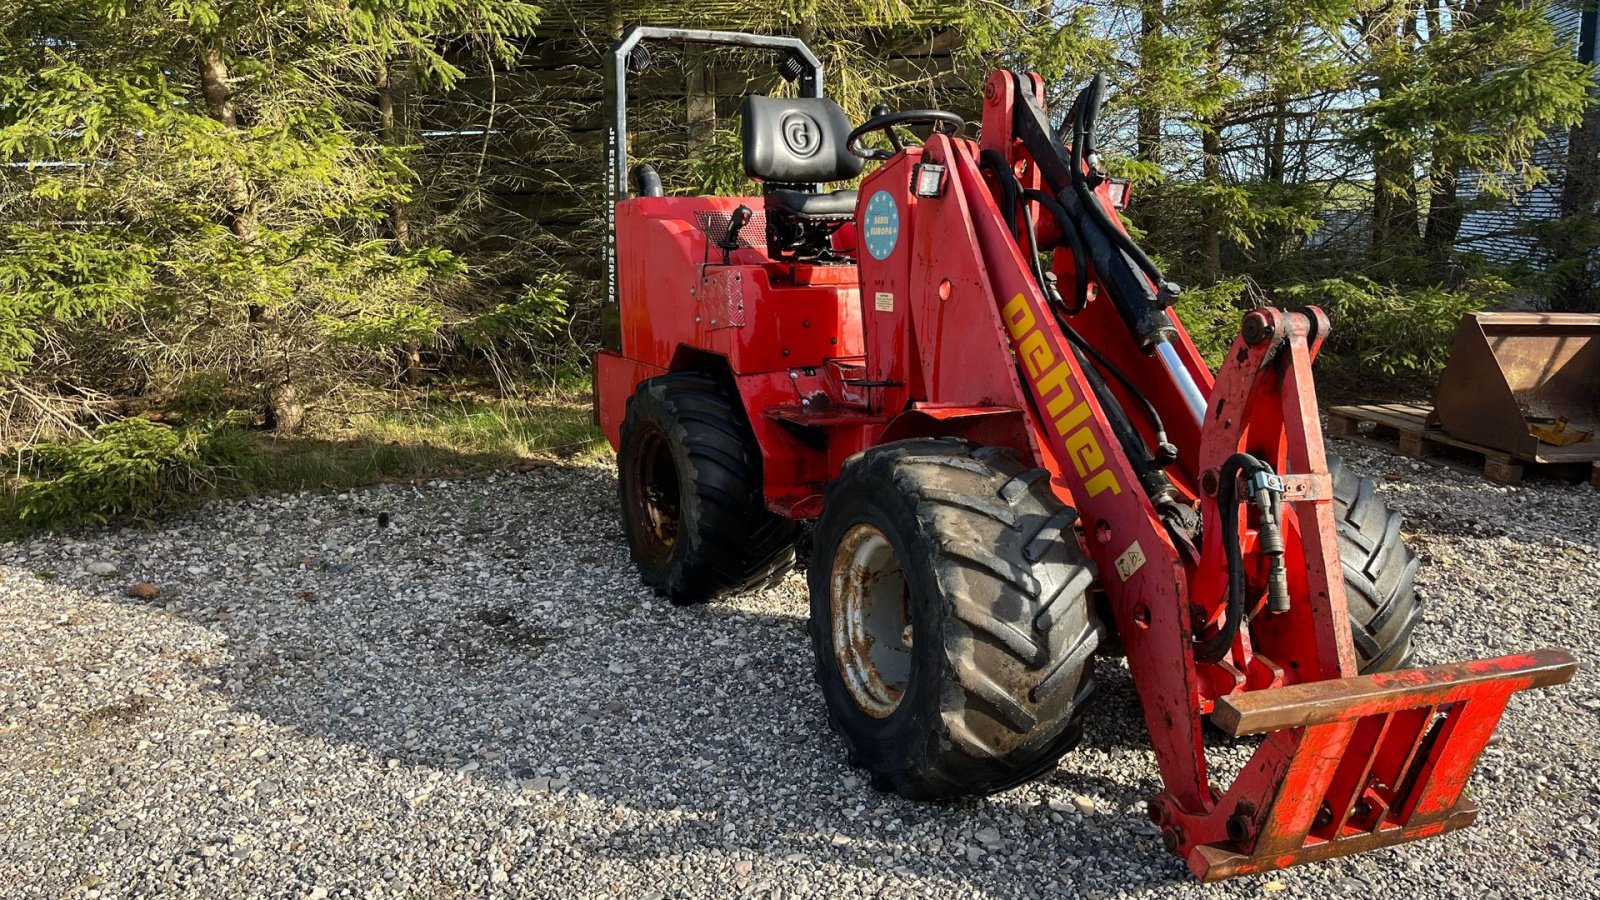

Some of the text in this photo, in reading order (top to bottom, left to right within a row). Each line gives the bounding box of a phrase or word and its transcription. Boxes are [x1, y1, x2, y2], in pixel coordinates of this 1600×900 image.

[870, 226, 892, 236] EUROPA
[608, 234, 615, 244] &
[1002, 292, 1122, 498] oehler
